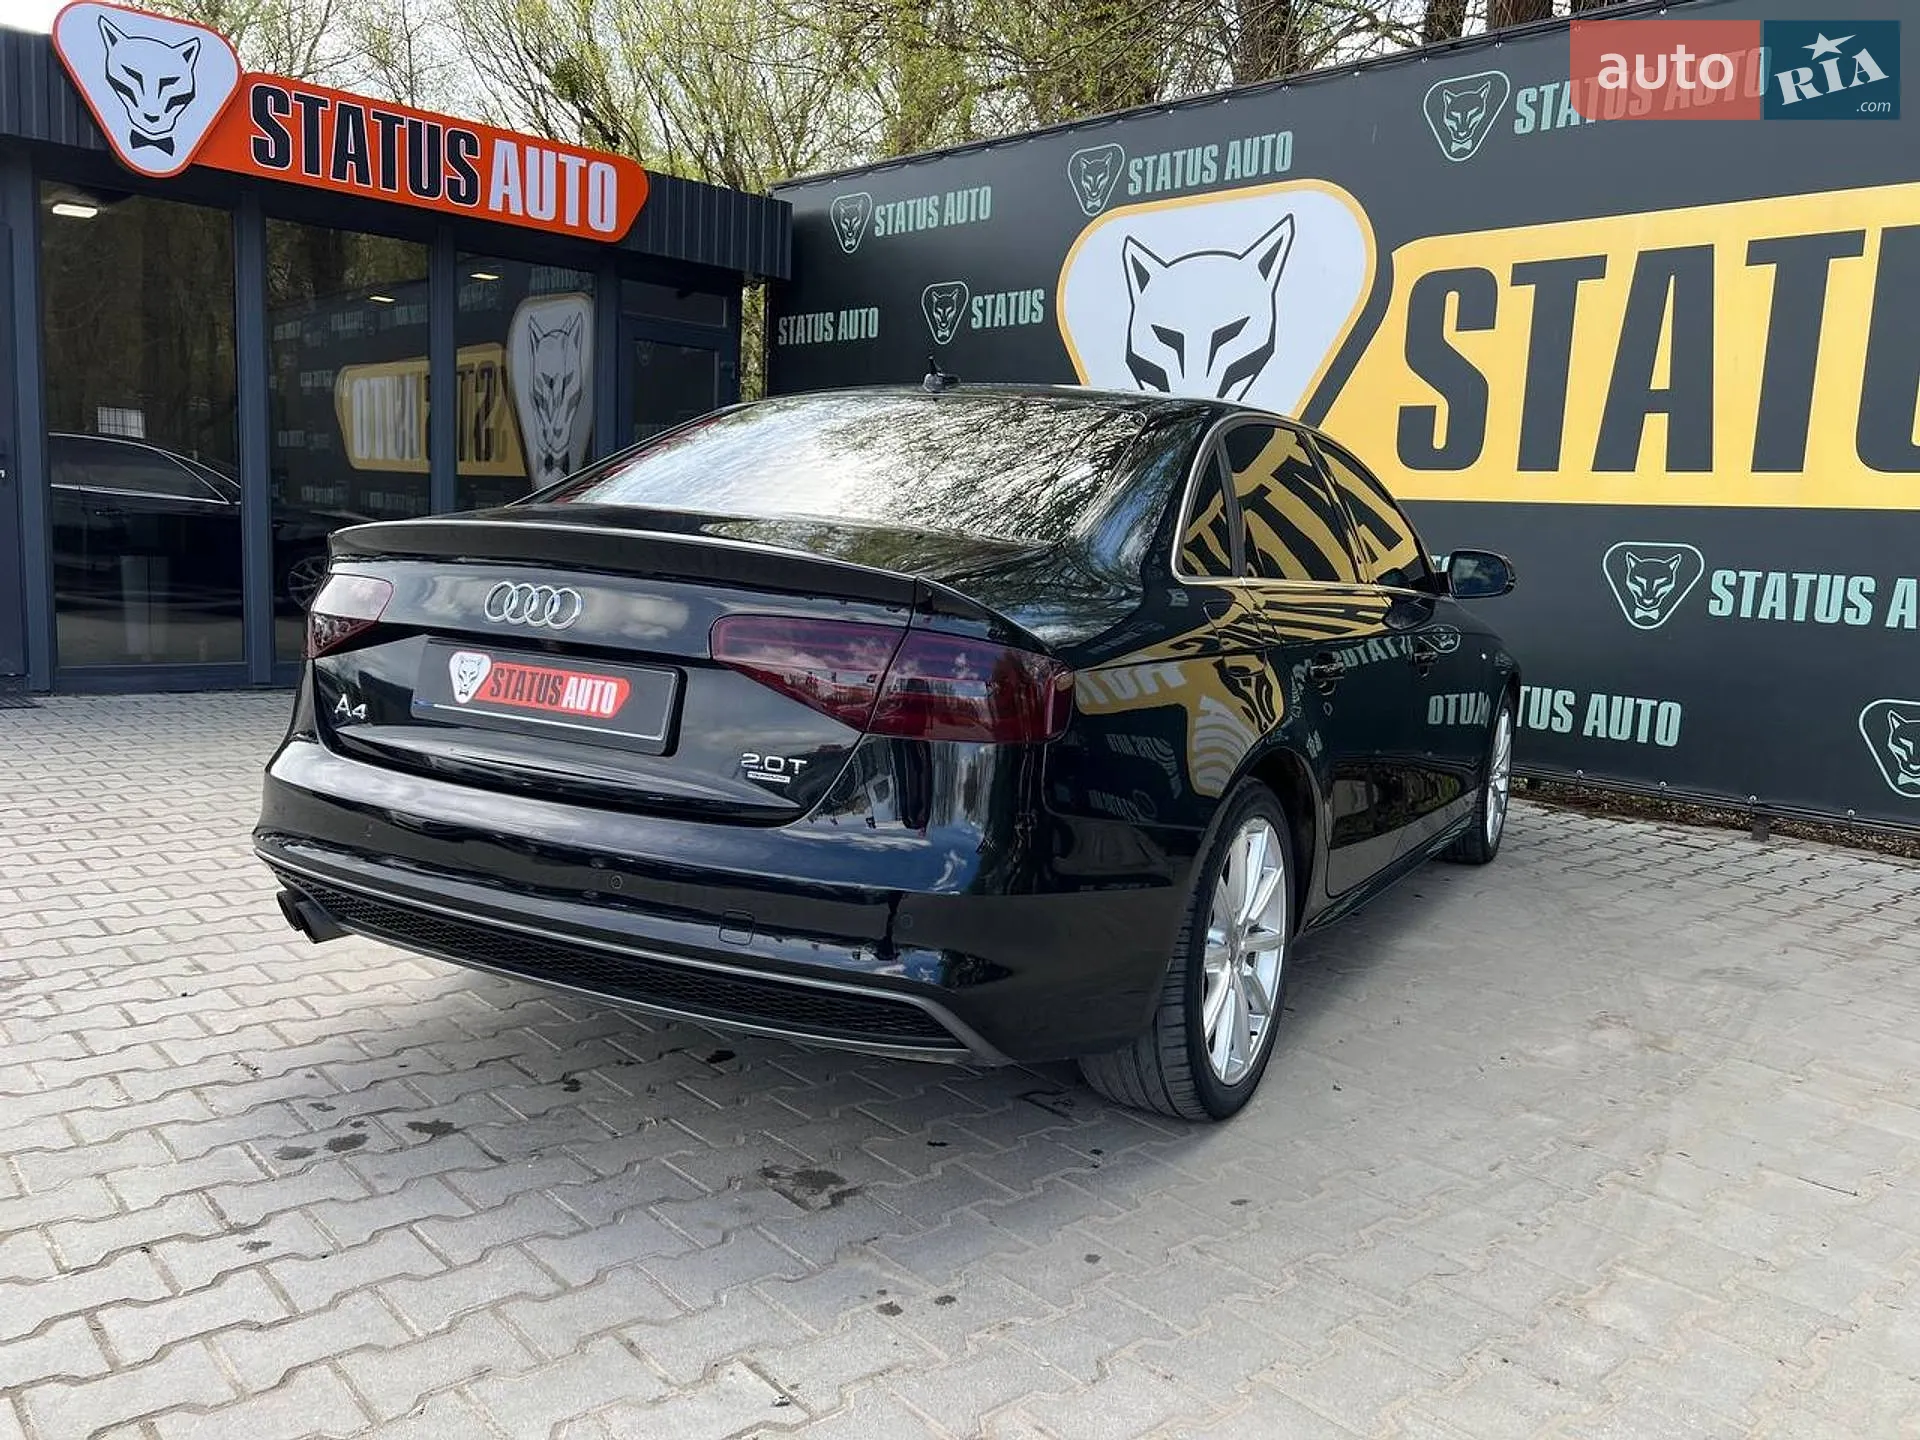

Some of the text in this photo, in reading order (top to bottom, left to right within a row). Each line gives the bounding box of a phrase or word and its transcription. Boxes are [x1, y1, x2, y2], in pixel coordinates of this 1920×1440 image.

[250, 83, 617, 232] STATUS AUTO
[1128, 130, 1293, 196] STATUS AUTO
[874, 186, 992, 238] STATUS AUTO
[778, 307, 879, 346] STATUS AUTO
[970, 288, 1045, 330] STATUS
[1708, 569, 1877, 626] STATUS
[334, 693, 368, 720] A4
[490, 667, 618, 714] STATUS AUTO
[1583, 692, 1682, 748] AUTO
[741, 752, 807, 774] 2.0T
